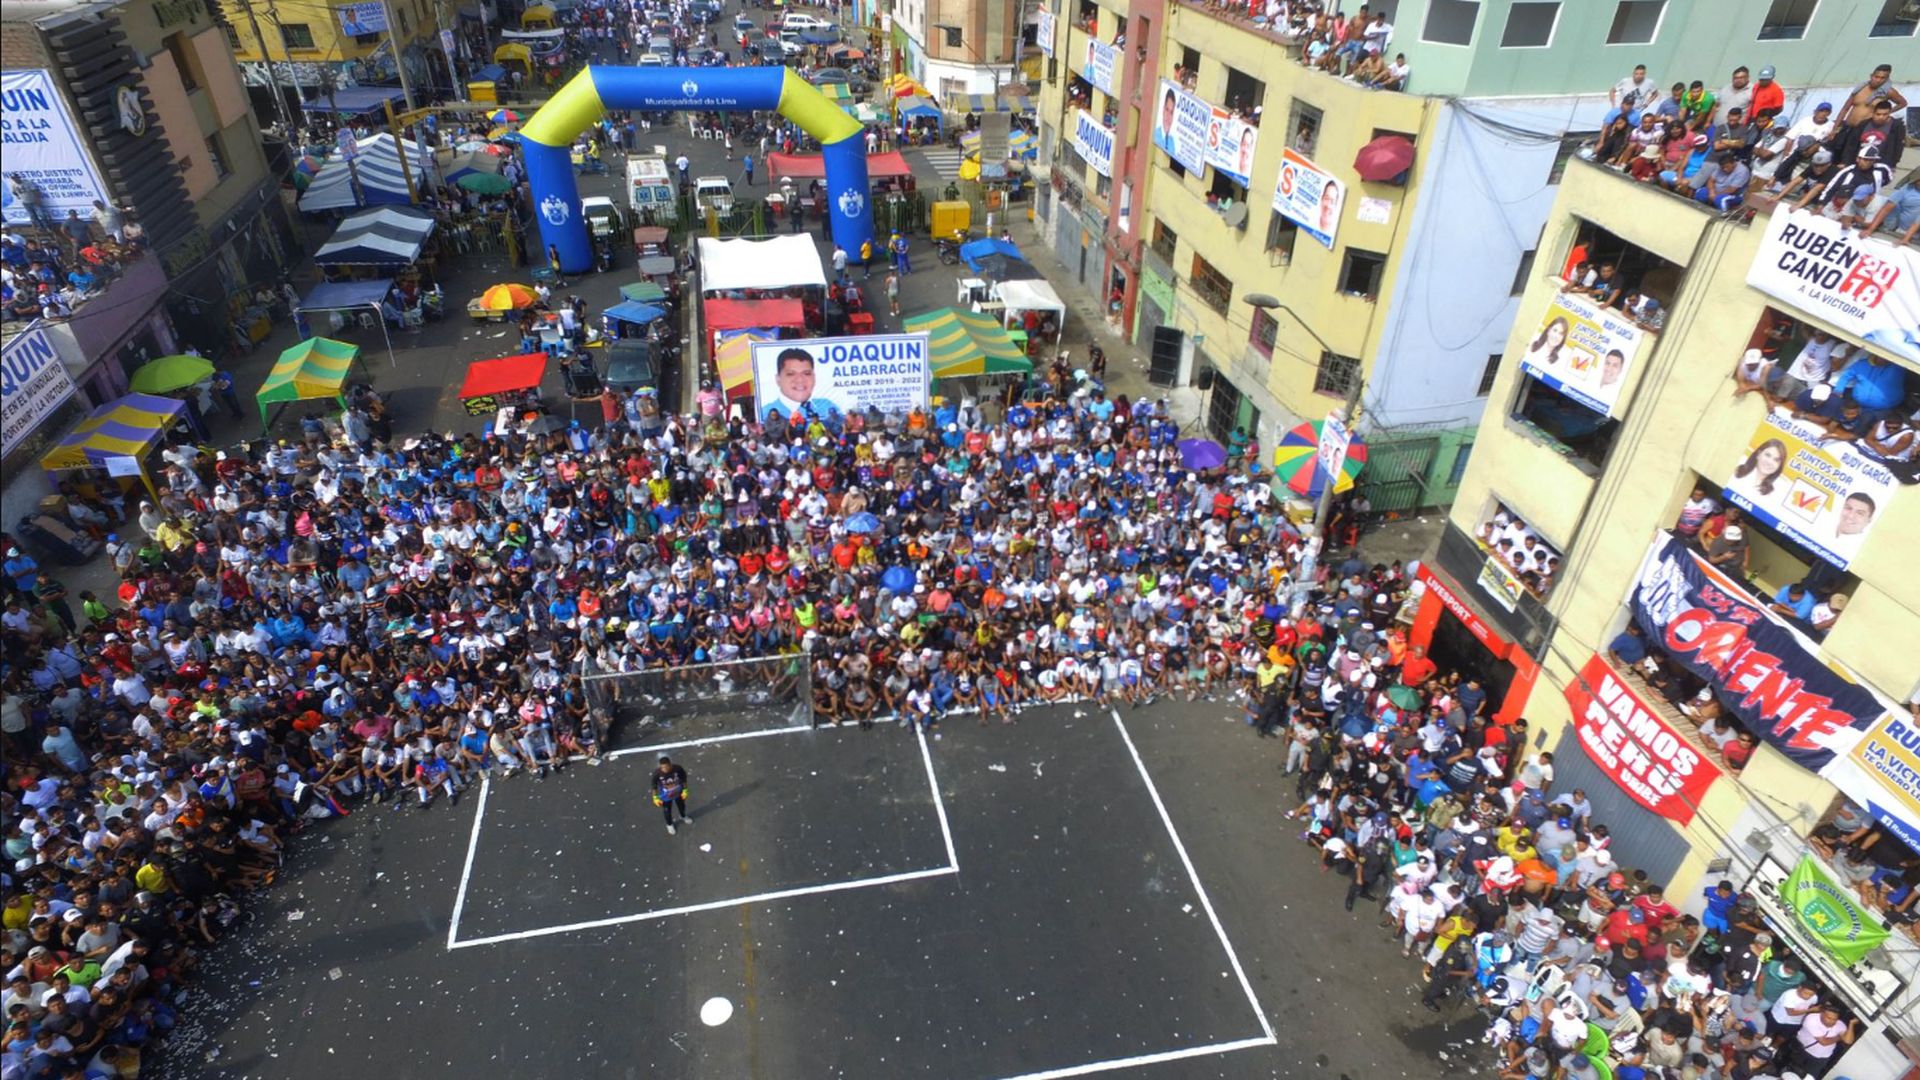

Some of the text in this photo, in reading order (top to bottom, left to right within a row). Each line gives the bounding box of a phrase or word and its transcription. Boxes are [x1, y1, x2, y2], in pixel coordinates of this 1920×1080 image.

[2, 89, 50, 112] UIN
[645, 97, 702, 106] Municipalidad
[716, 97, 737, 105] Lima
[16, 119, 27, 129] A
[30, 118, 51, 129] LA
[43, 168, 84, 177] DISTRITO
[1778, 222, 1860, 269] RUBÉN
[1777, 251, 1843, 290] CANO
[1798, 285, 1867, 321] A LA VICTORIA
[818, 342, 921, 364] JOAQUIN
[832, 362, 921, 377] ALBARRACIN
[43, 377, 70, 403] VICTORIA
[833, 379, 871, 387] ALCALDE
[1765, 413, 1792, 436] ESTHER
[1797, 450, 1854, 485] JUNTOS POR
[1840, 452, 1862, 471] RUDY
[1789, 460, 1848, 498] LA VICTORIA
[1730, 493, 1753, 512] LIMA
[1427, 576, 1472, 621] LIVESPORT
[1598, 673, 1699, 776] VAMOS
[1585, 699, 1685, 796] PERÚ
[1867, 740, 1886, 760] LA
[1863, 751, 1875, 763] TE
[1875, 761, 1911, 791] QUIERO
